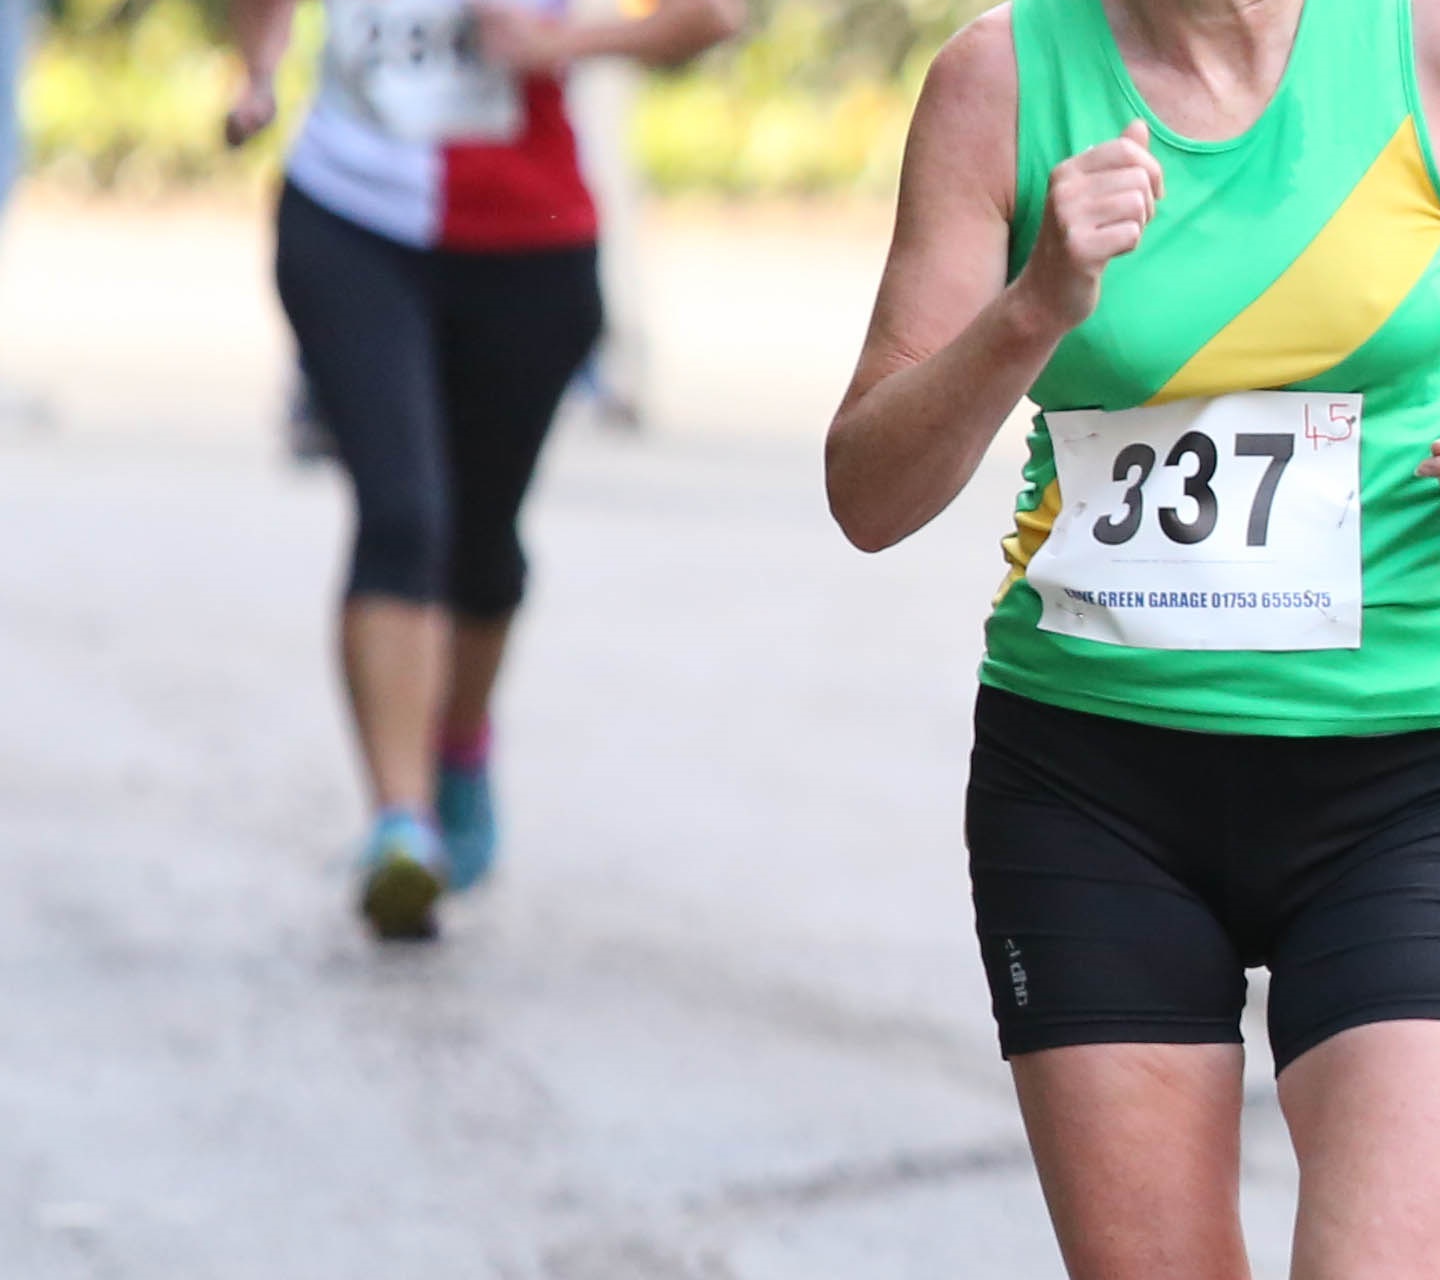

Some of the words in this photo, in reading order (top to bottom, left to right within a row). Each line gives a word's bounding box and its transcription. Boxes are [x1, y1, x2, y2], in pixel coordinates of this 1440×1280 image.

[1304, 403, 1353, 451] 45
[1093, 431, 1295, 547] 337
[1098, 590, 1144, 608] GREEN
[1148, 591, 1208, 608] GARAGE
[1211, 592, 1257, 608] 01753
